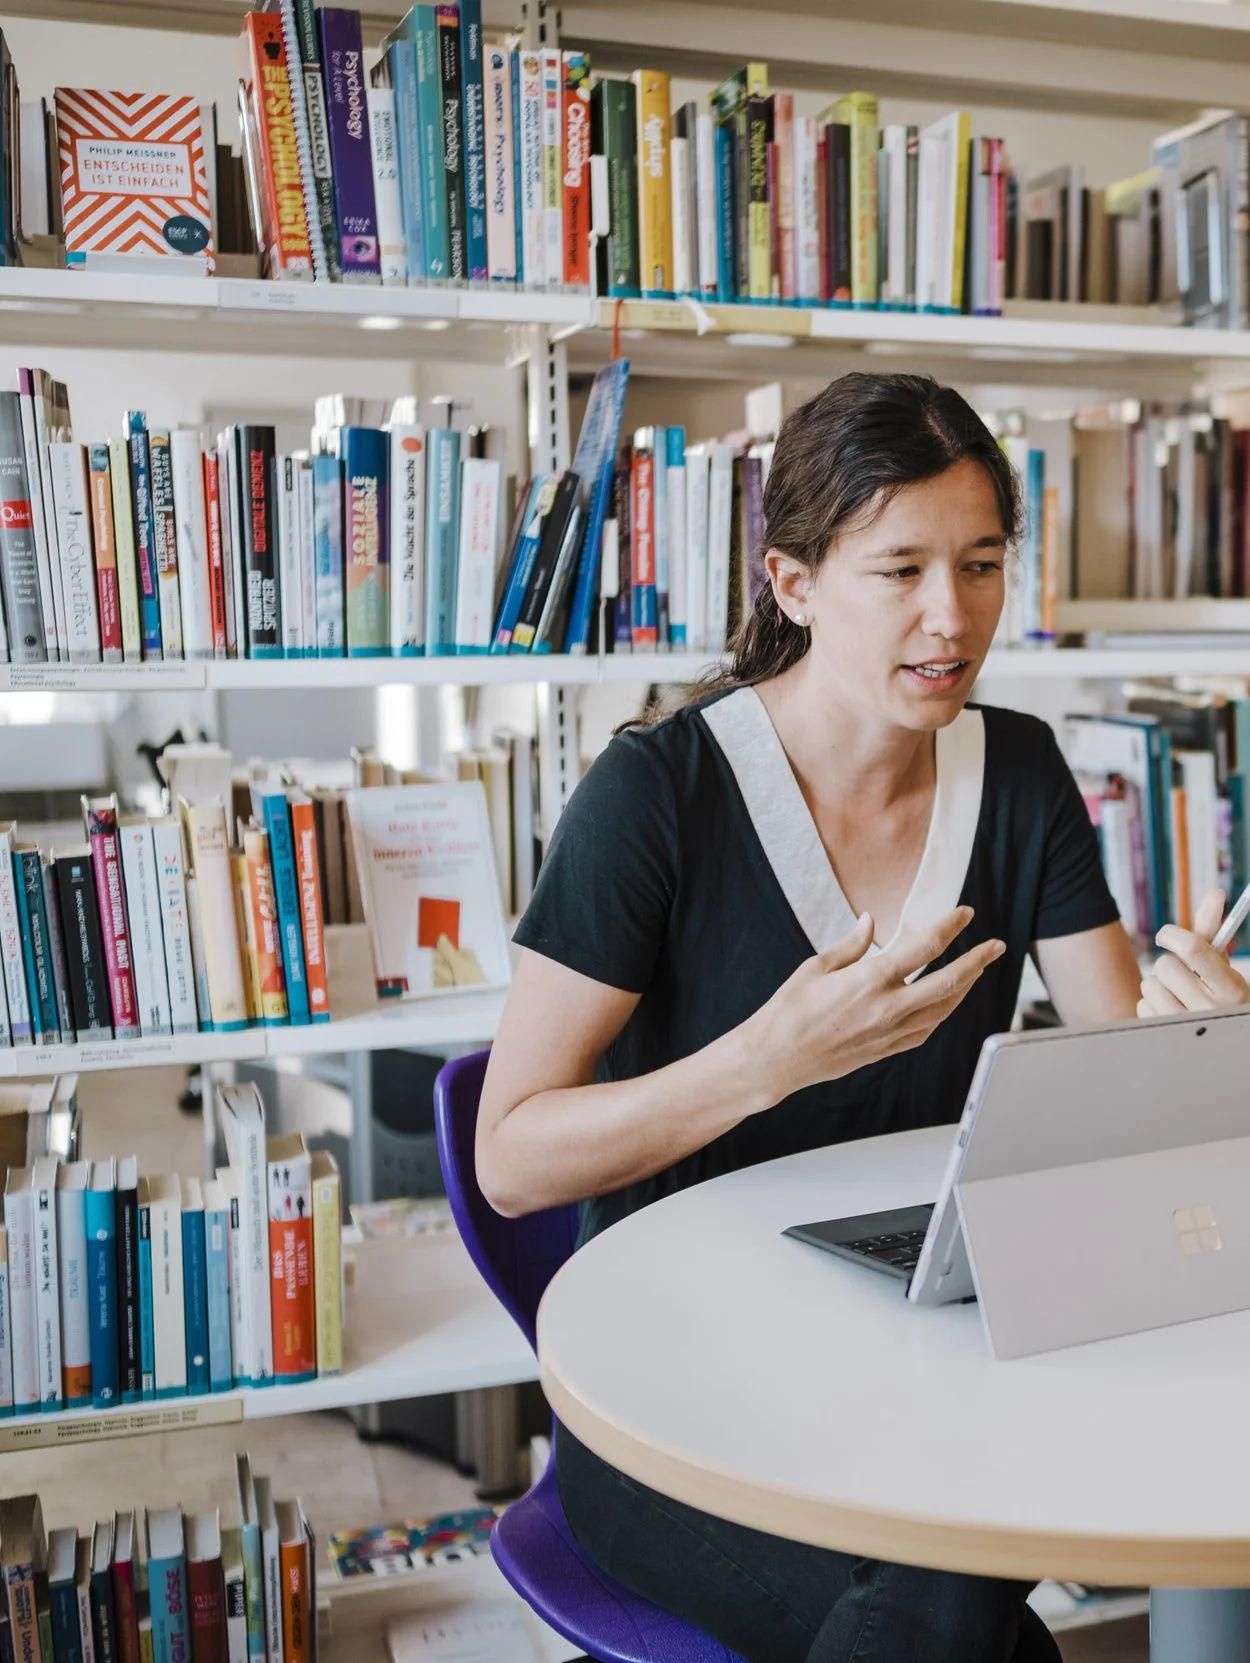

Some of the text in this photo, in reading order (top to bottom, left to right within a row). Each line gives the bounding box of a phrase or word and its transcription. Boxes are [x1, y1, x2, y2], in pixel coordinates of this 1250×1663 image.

[263, 65, 288, 83] THE
[331, 50, 342, 63] for
[334, 76, 345, 103] Level
[343, 50, 365, 140] Psychology
[308, 74, 329, 174] PSYCHOLOGY
[442, 99, 460, 173] Psychology
[563, 102, 586, 187] Choosing
[83, 159, 185, 174] ENTSCHEIDEN
[89, 146, 176, 159] PHILIP MEISSNER
[264, 81, 308, 237] PSYCHOLOGY
[493, 134, 506, 216] Psychology
[92, 174, 179, 189] IST EINFACH
[467, 155, 480, 208] PSYCHOLOGY
[451, 230, 463, 280] PEARSON
[1, 467, 20, 475] CAIN
[151, 446, 165, 505] WAFFLES
[163, 480, 172, 499] ARE
[402, 459, 416, 501] Sprache
[438, 438, 452, 523] EINSAMKEIT
[1, 506, 31, 522] Quiet
[136, 486, 149, 522] Gifted
[250, 449, 267, 553] DIGITALE DEMENZ
[351, 476, 366, 566] SOZIALE
[98, 510, 108, 552] Psychology
[156, 512, 168, 572] SPAGHETTI
[166, 519, 176, 565] GIRLS ARE
[65, 519, 92, 637] The Cyber Effect
[403, 564, 414, 581] Die
[248, 570, 263, 630] MANFRED
[262, 578, 276, 630] SPITZER
[104, 835, 115, 858] THE
[300, 830, 313, 881] Training
[373, 848, 422, 860] inneren
[23, 856, 38, 893] blink
[106, 861, 124, 937] SENSATIONAL
[163, 855, 183, 930] DEIATE
[31, 913, 47, 1000] MALCOLM GLADWELL
[116, 940, 129, 969] PAST
[164, 1567, 183, 1615] BÖSE
